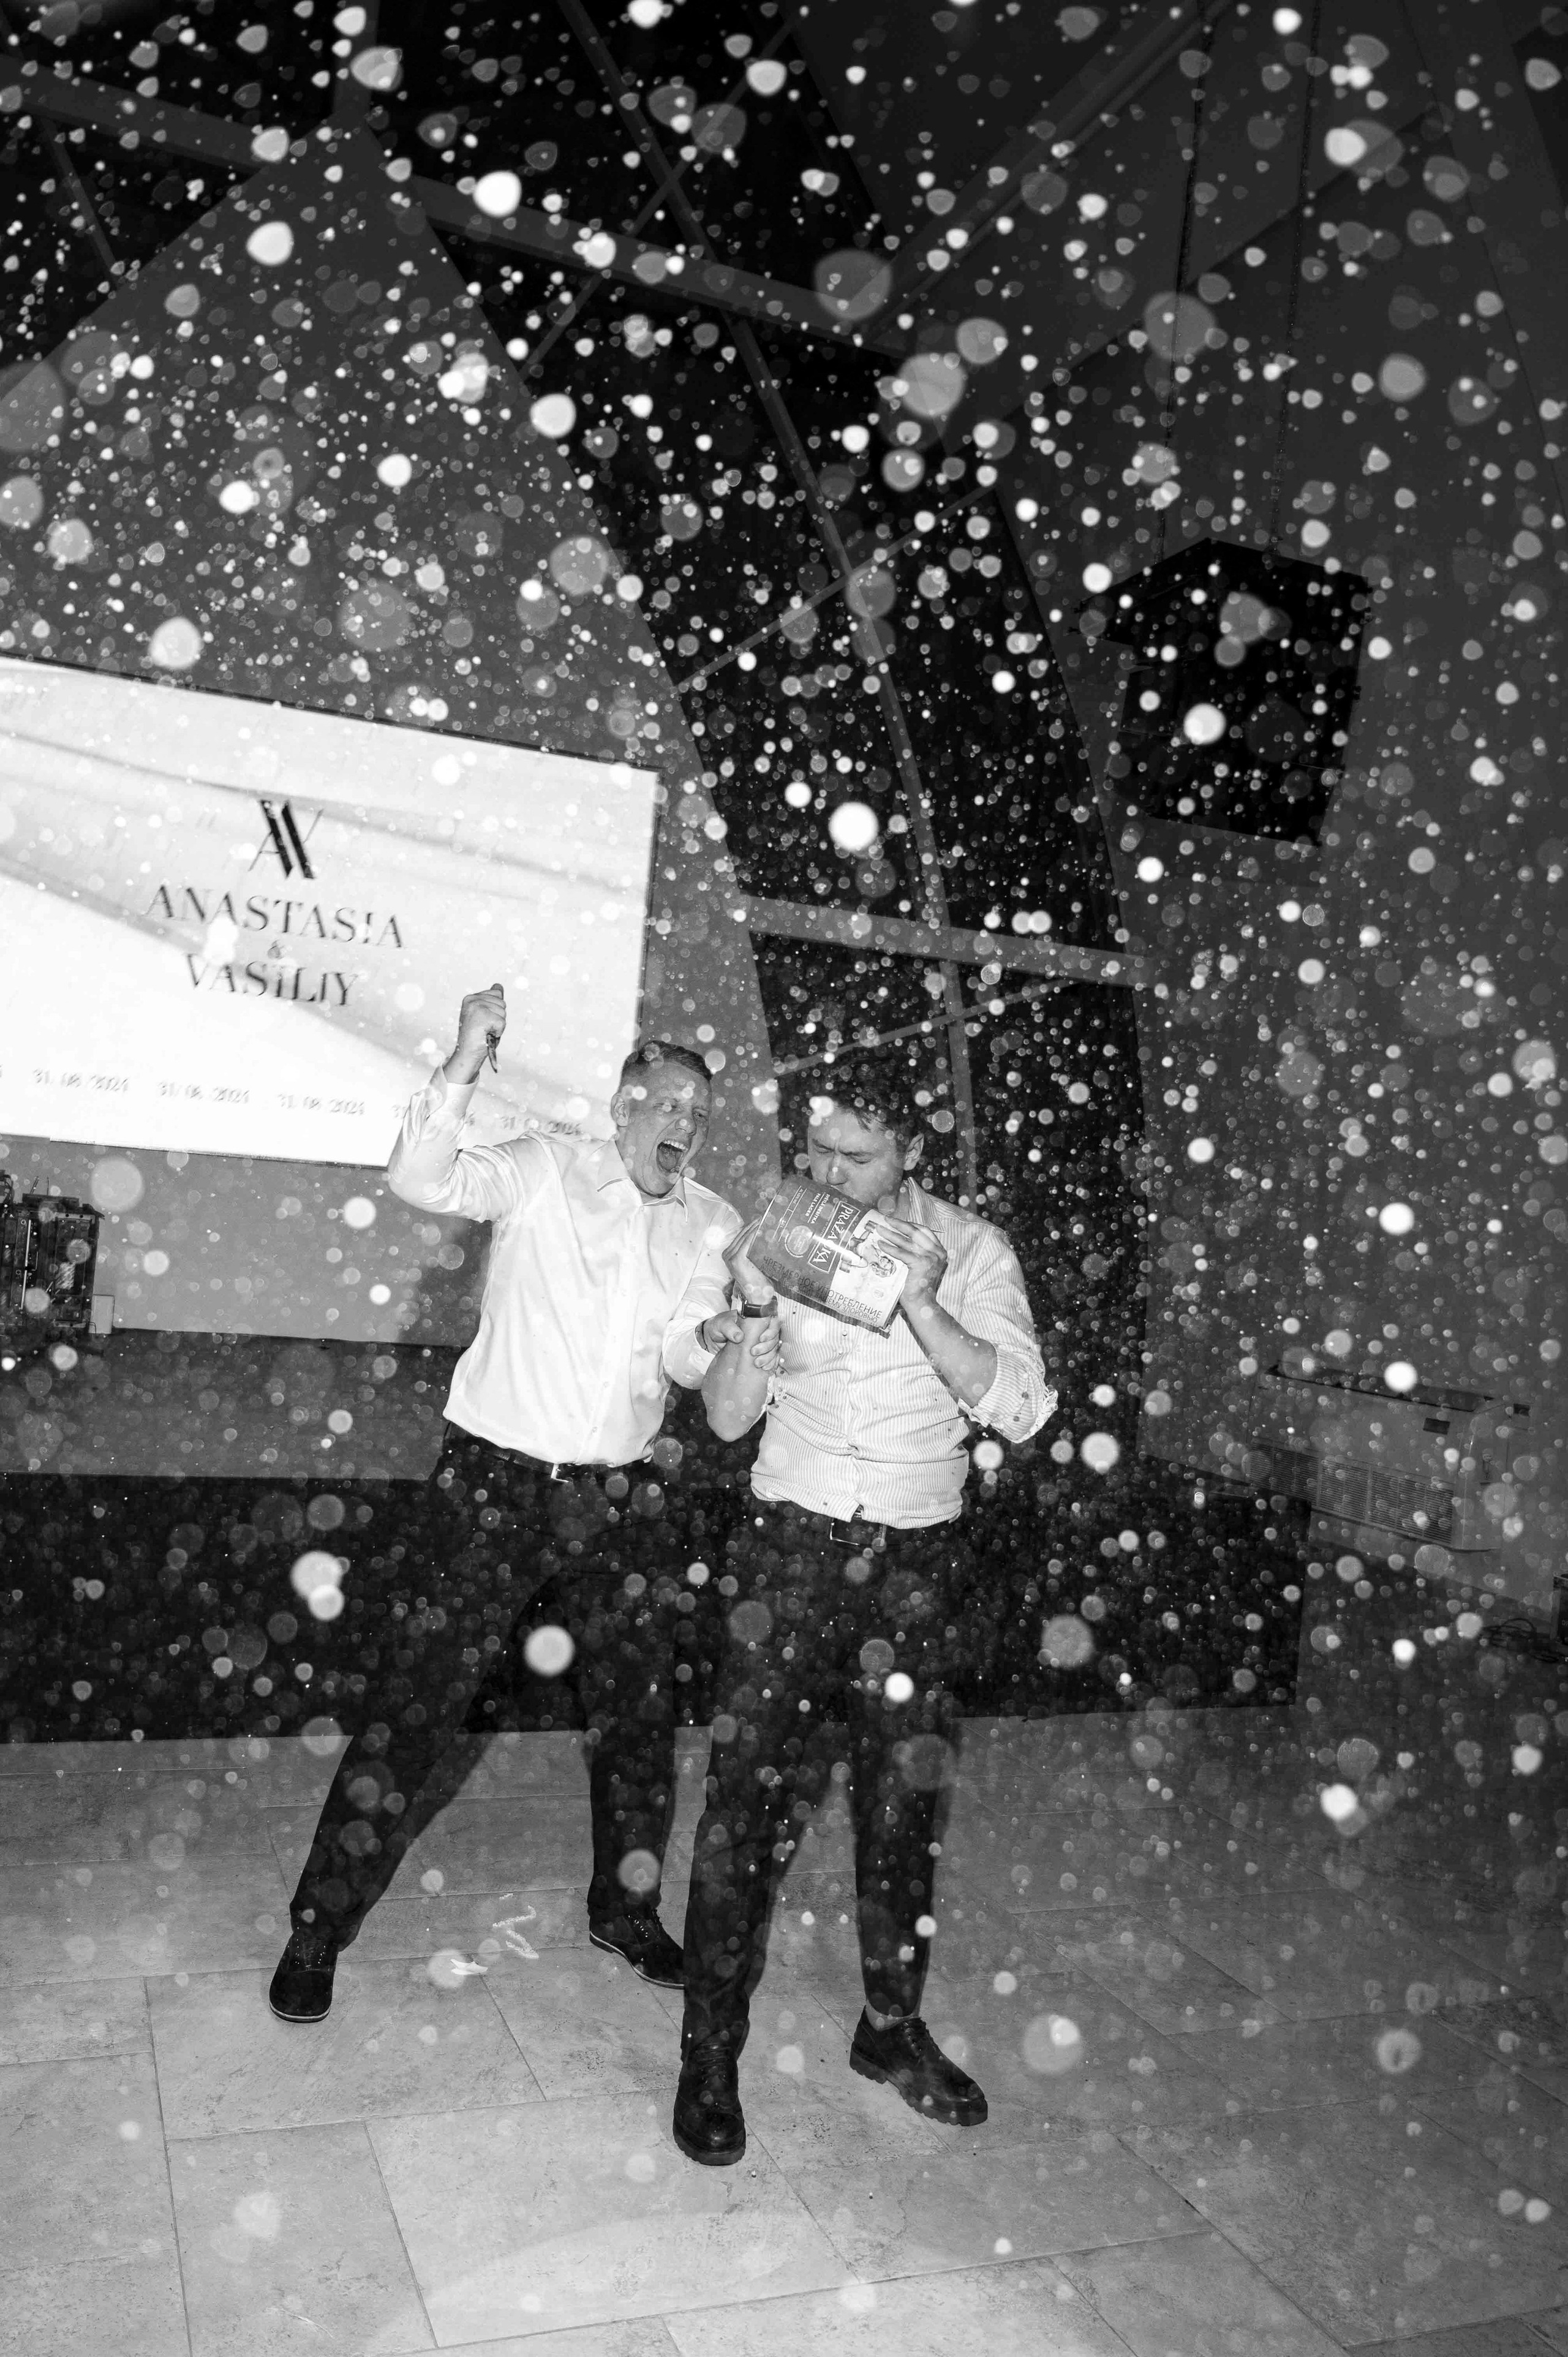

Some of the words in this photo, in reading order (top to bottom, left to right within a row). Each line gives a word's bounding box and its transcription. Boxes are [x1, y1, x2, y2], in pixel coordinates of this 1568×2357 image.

[144, 884, 406, 948] ANASTASIA
[267, 940, 284, 959] &
[187, 953, 359, 1006] VASILIY
[812, 1204, 854, 1263] PRAŽAKA
[763, 1256, 816, 1287] ЧРЕЗМЕРНОЕ
[816, 1284, 883, 1319] УПОТРЕБЛЕНИЕ
[841, 1303, 878, 1323] ЗДОРОВЬЮ
